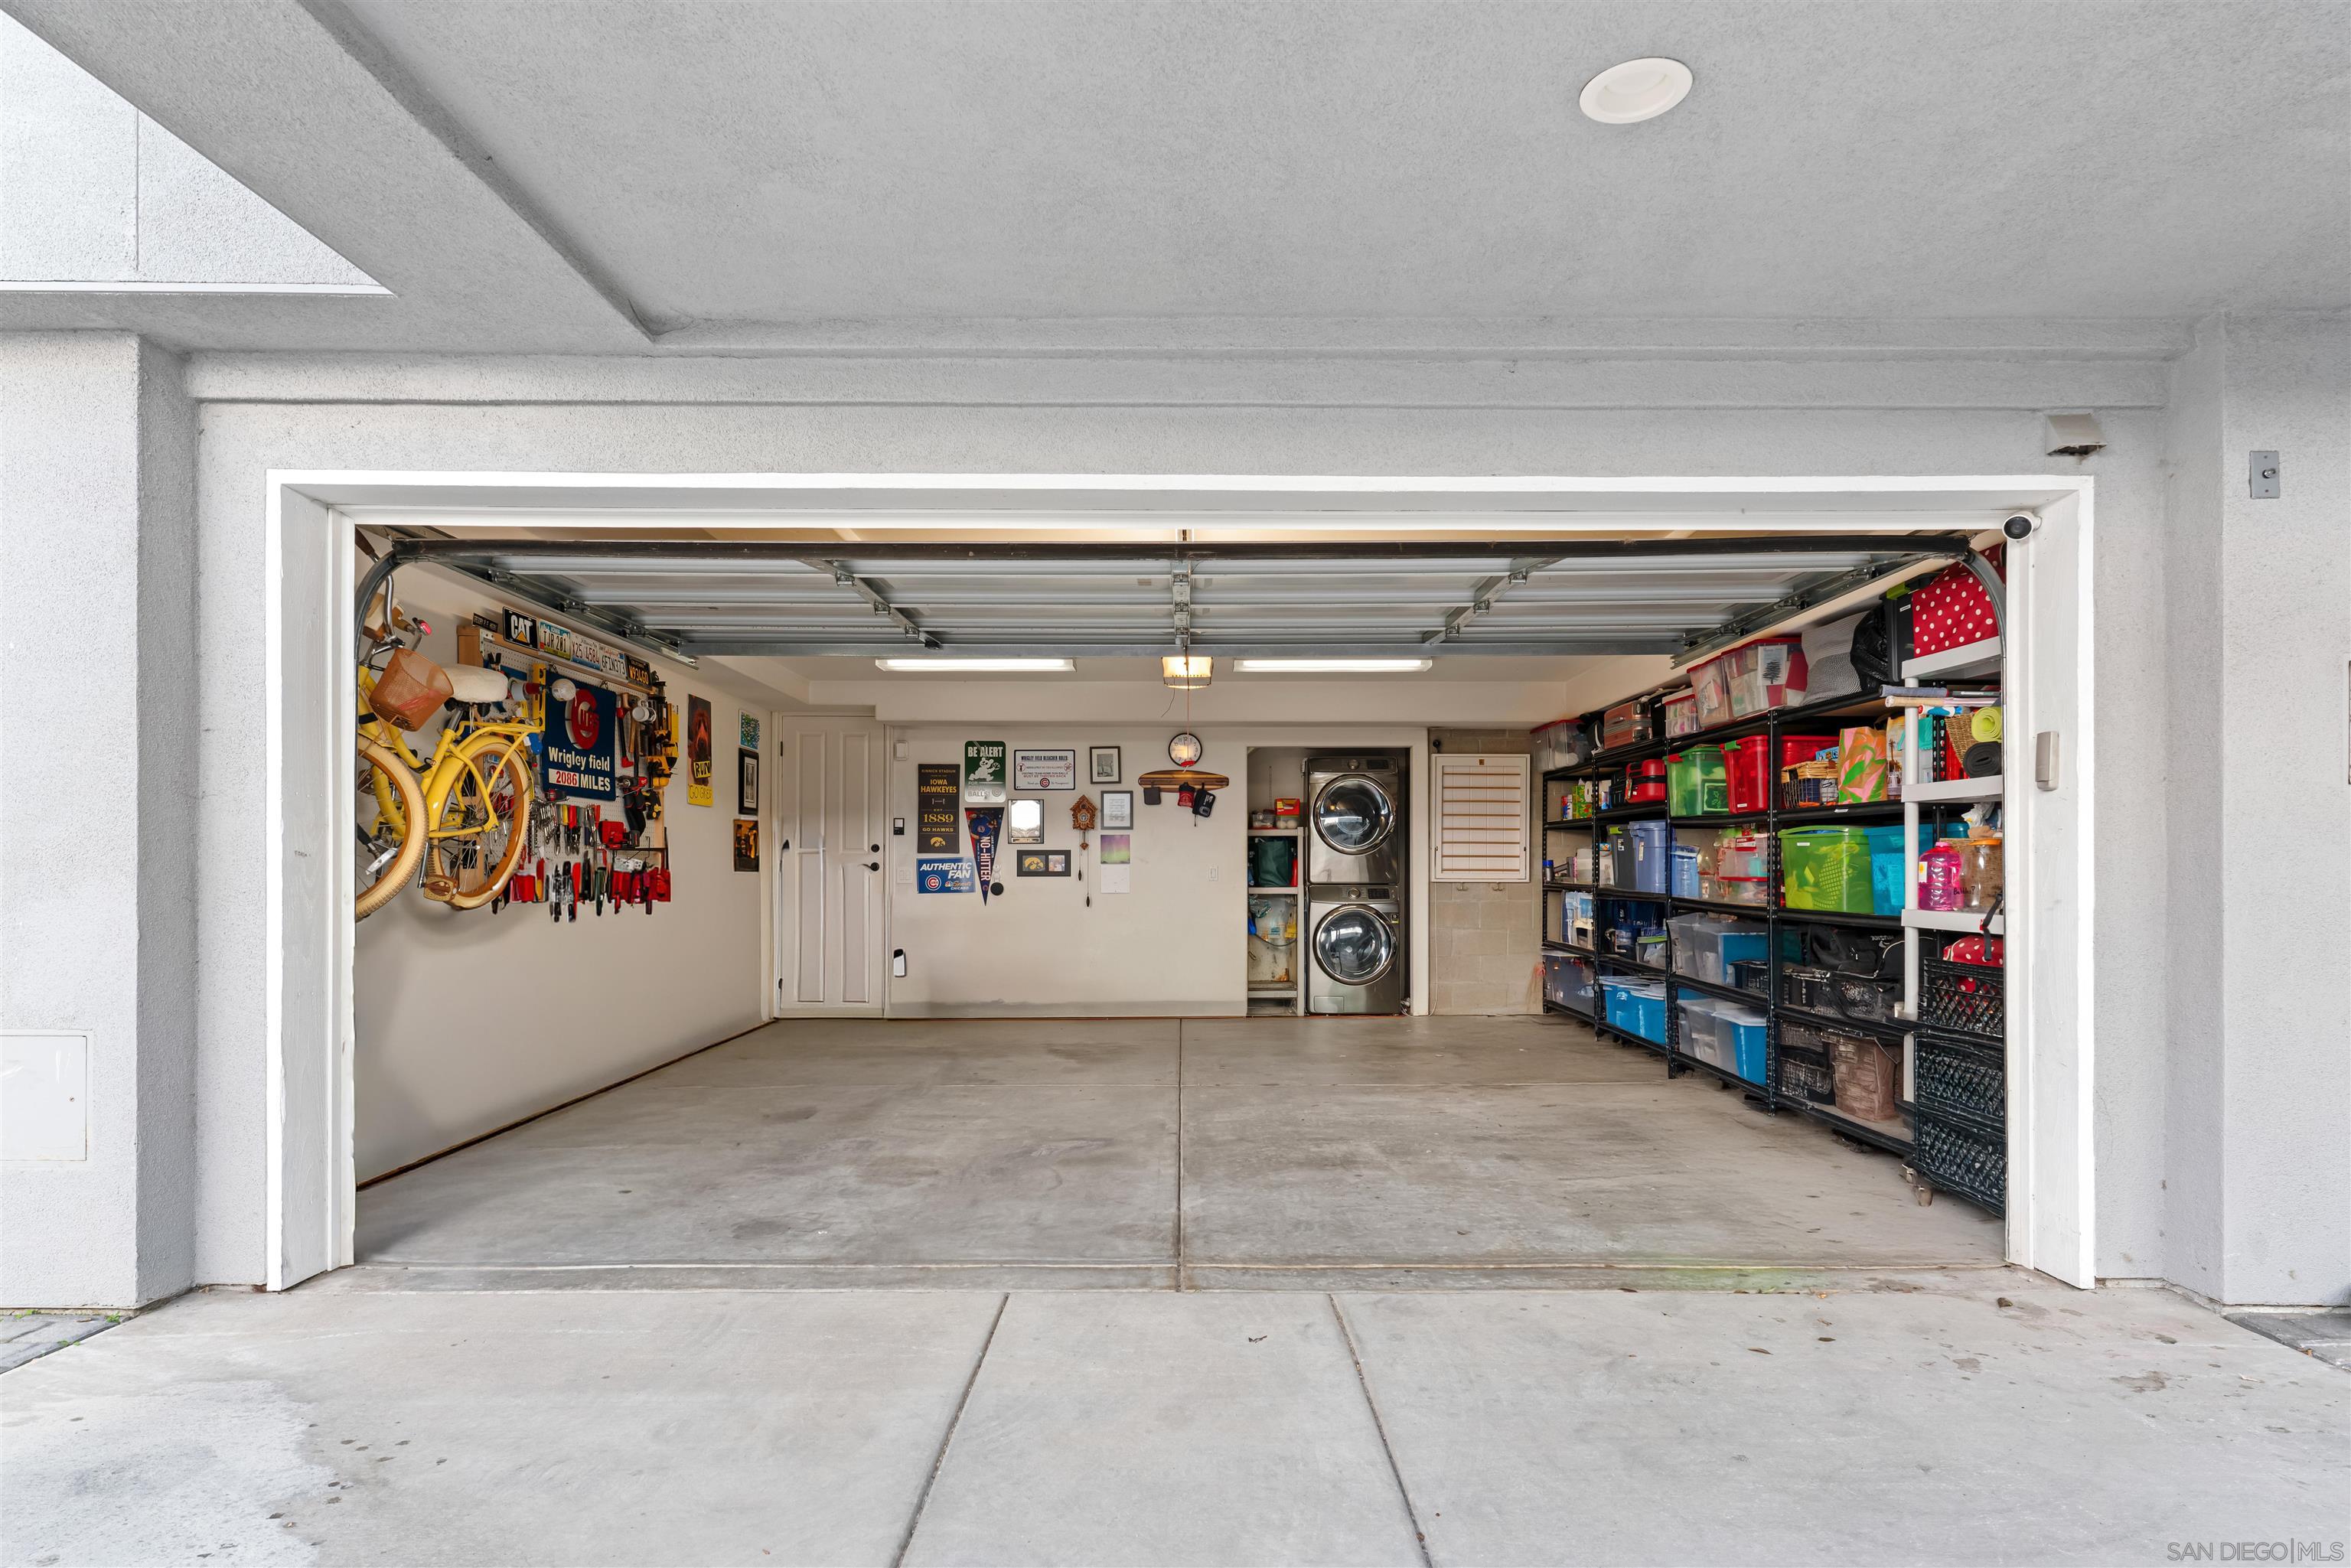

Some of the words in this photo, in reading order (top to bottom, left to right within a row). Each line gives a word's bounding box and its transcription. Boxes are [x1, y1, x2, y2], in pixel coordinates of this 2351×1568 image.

[510, 614, 533, 644] CAT
[549, 746, 587, 771] Wrigley
[589, 754, 610, 771] field
[967, 746, 978, 758] BE
[980, 746, 1003, 758] ALERT
[695, 761, 711, 777] RUN
[556, 771, 578, 787] 2086
[580, 773, 611, 792] MILES
[924, 813, 954, 823] 1889
[920, 862, 972, 871] AUTHENTIC
[980, 836, 991, 881] NO-HITTER
[947, 869, 971, 879] FAN
